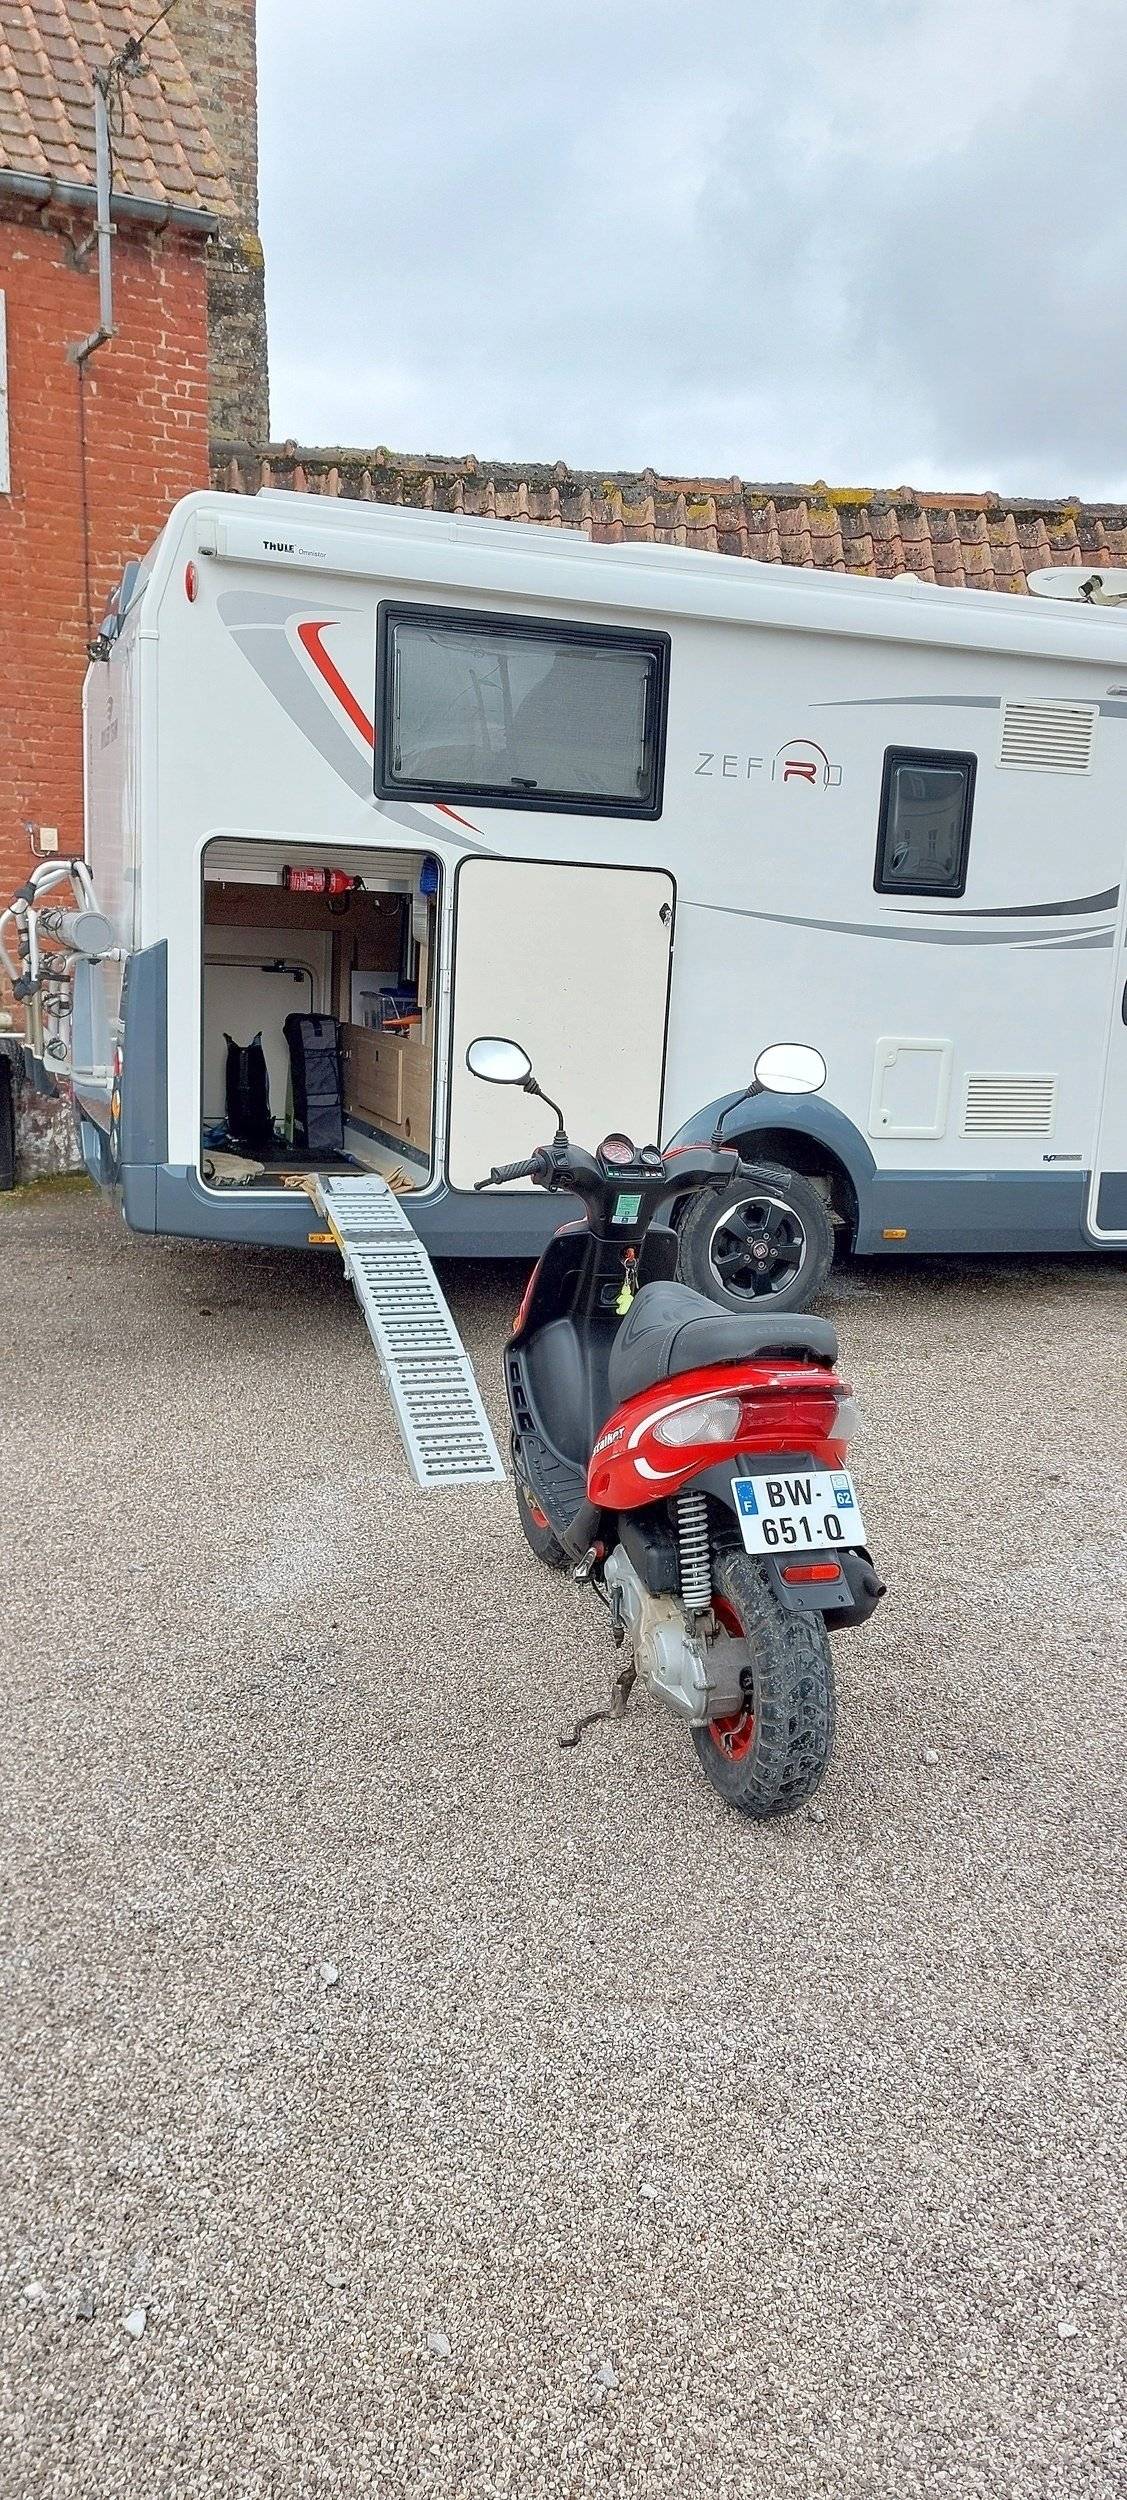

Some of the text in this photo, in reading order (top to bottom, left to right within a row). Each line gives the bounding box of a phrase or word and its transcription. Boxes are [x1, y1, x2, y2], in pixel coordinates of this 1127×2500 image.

[263, 541, 294, 553] THULE
[695, 752, 843, 787] ZEFIRO
[836, 1492, 851, 1505] 62
[743, 1501, 753, 1513] F
[762, 1514, 845, 1545] 651-Q
